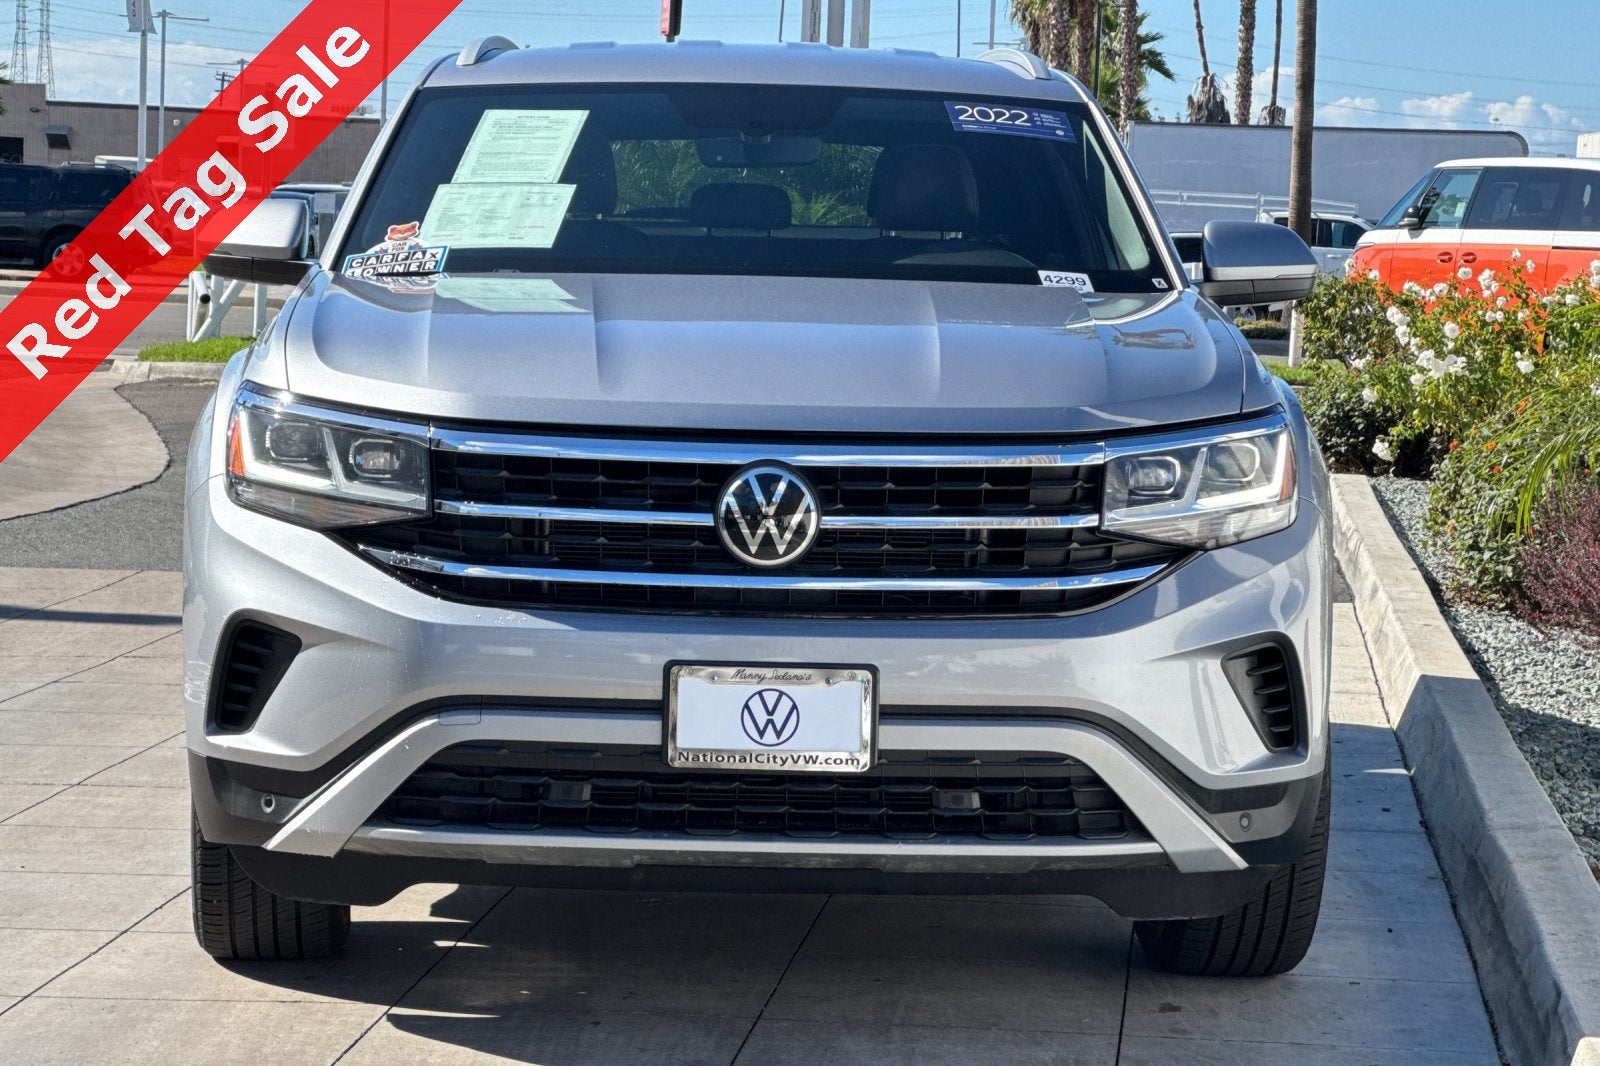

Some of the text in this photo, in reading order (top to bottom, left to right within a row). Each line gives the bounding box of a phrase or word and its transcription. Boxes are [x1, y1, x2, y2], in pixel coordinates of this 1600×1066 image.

[954, 105, 1032, 126] 2022
[351, 250, 440, 267] CARFAX
[363, 261, 437, 277] OWNER
[1043, 274, 1086, 285] 4299
[730, 668, 767, 684] Manny
[677, 751, 861, 767] NationalCityVW.com
